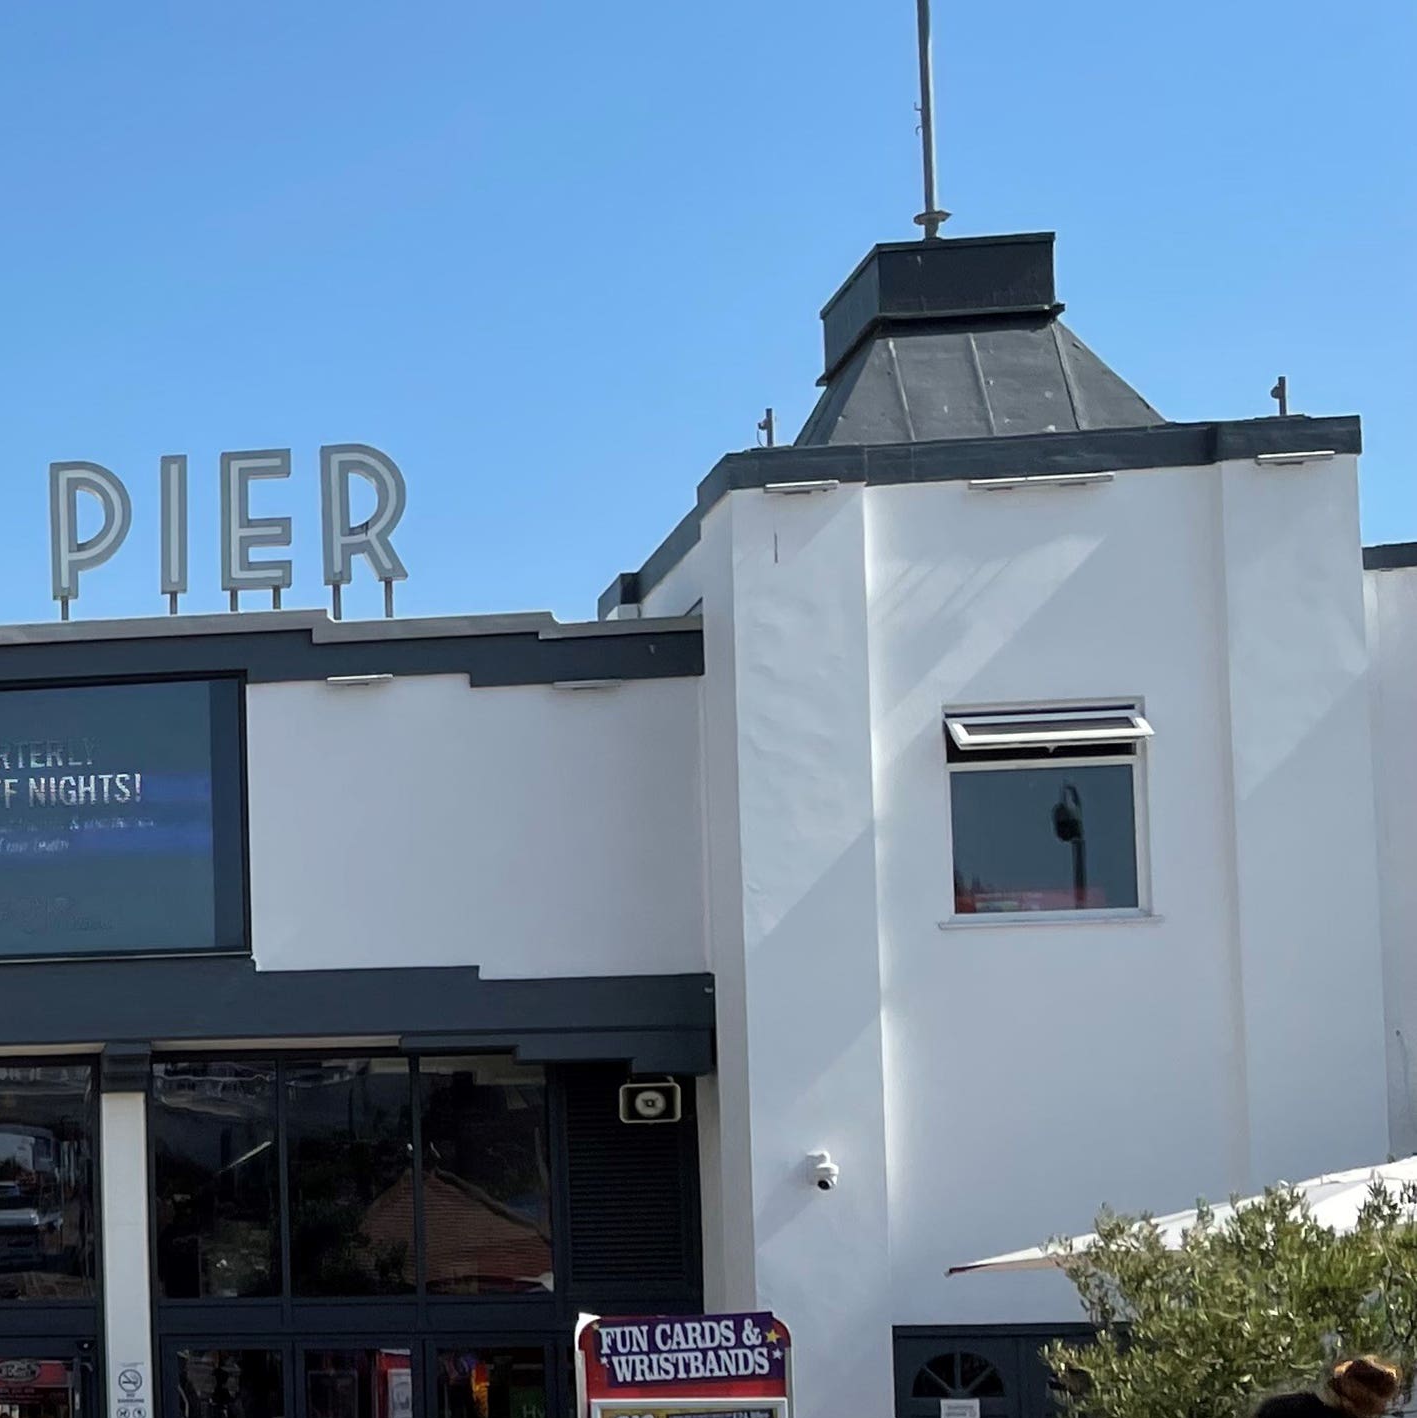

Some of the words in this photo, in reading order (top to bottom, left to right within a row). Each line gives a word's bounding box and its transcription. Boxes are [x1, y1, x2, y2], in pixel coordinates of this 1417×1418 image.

[49, 443, 407, 600] PIER
[29, 773, 142, 807] NIGHTS!
[599, 1325, 649, 1354] FUN
[654, 1319, 737, 1350] CARDS
[741, 1317, 763, 1346] &
[611, 1347, 770, 1382] WRISTBANDS
